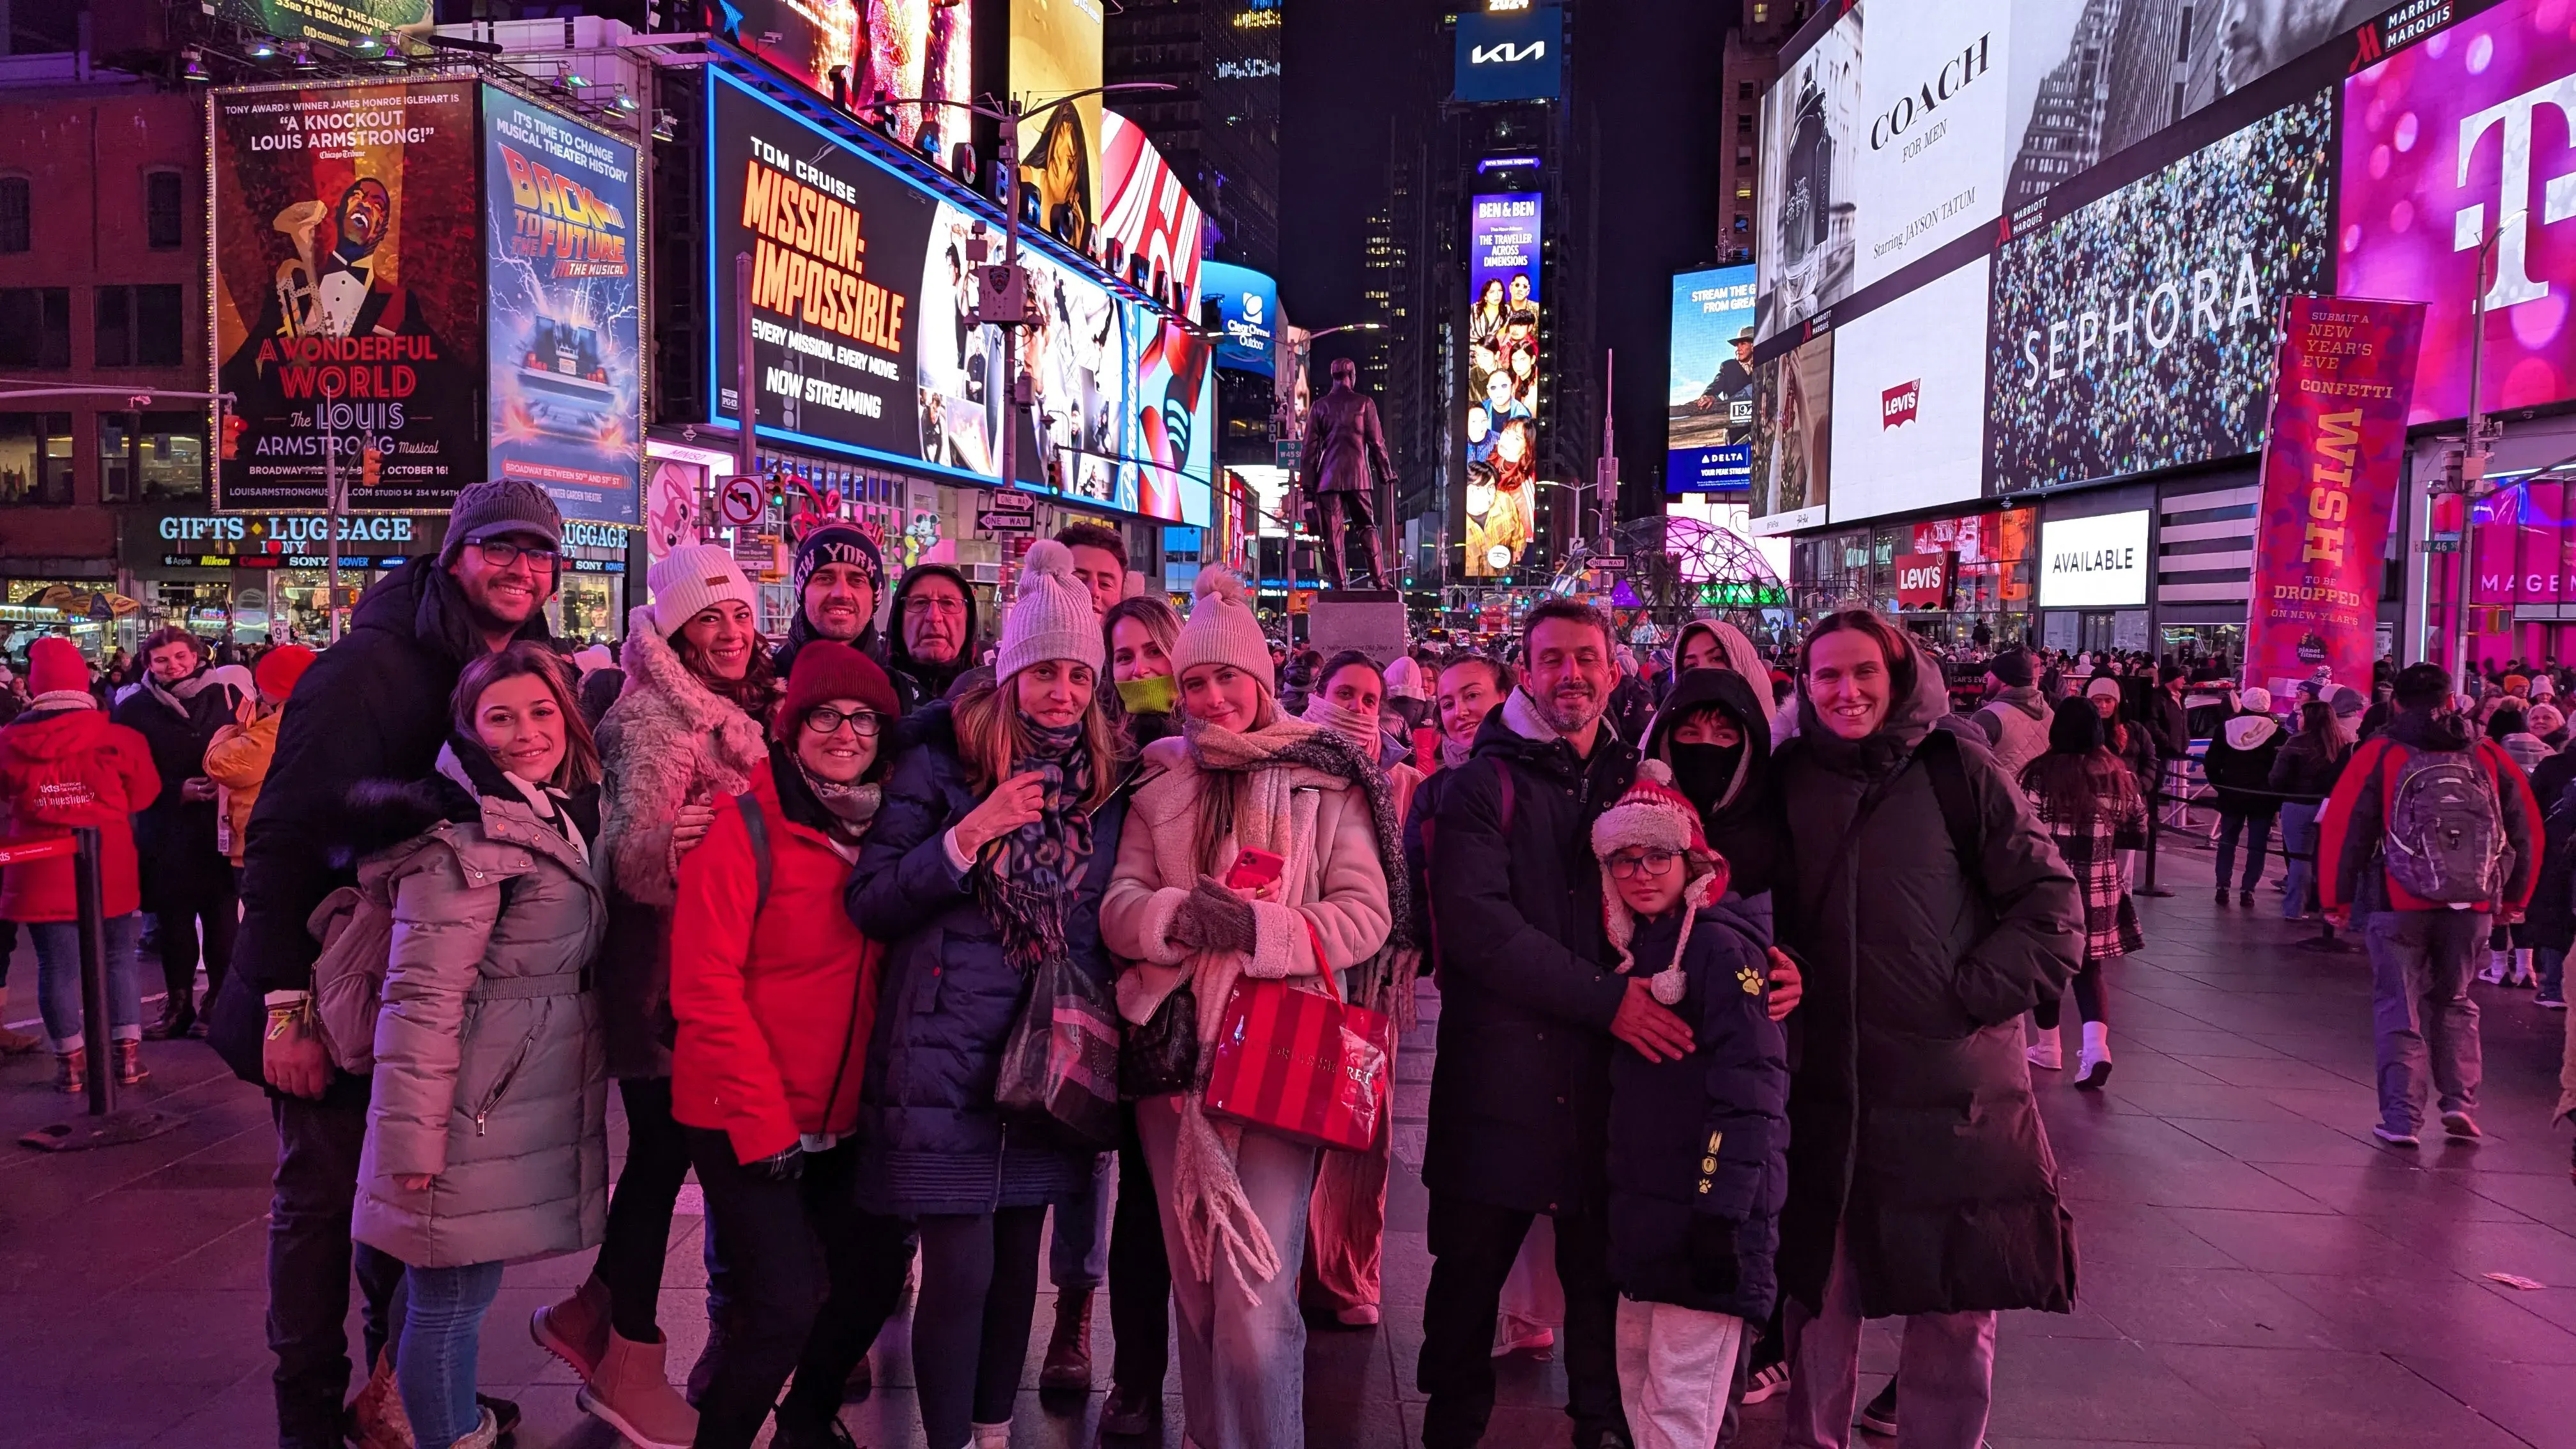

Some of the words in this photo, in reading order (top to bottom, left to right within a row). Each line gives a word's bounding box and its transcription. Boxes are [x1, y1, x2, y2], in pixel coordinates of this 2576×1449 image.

[304, 6, 312, 17] &
[315, 9, 372, 35] BROADWAY
[346, 8, 392, 31] THEATRE
[2388, 6, 2450, 48] MARQUIS
[317, 33, 349, 47] COMPANY
[1871, 31, 1991, 151] COACH
[226, 105, 249, 114] TONY
[293, 101, 328, 111] WINNER
[331, 98, 360, 109] JAMES
[362, 96, 401, 107] MONROE
[404, 95, 448, 105] IGLEHART
[450, 94, 459, 102] IS
[305, 111, 404, 129] KNOCKOUT
[251, 133, 302, 151] LOUIS
[513, 110, 532, 128] IT'S
[534, 118, 556, 140] TIME
[559, 130, 573, 145] TO
[574, 137, 613, 164] CHANGE
[1903, 138, 1922, 163] FOR
[1923, 118, 1947, 149] MEN
[319, 151, 342, 160] Chicago
[342, 150, 365, 158] Tribune
[497, 118, 542, 149] MUSICAL
[544, 139, 587, 167] THEATER
[589, 158, 628, 183] HISTORY
[751, 136, 788, 171] TOM
[795, 162, 856, 204] CRUISE
[500, 142, 617, 230] BACK
[742, 160, 866, 275] MISSION:
[1479, 203, 1501, 218] BEN
[1503, 202, 1512, 217] &
[1512, 201, 1535, 217] BEN
[2013, 196, 2048, 222] MARRIOTT
[1874, 233, 1903, 259] Starring
[1905, 208, 1940, 245] JAYSON
[1941, 186, 1976, 221] TATUM
[2013, 212, 2043, 234] MARQUIS
[514, 209, 540, 236] TO
[540, 221, 626, 263] FUTURE
[1479, 235, 1492, 245] THE
[1494, 234, 1532, 245] TRAVELLER
[511, 236, 539, 257] THE
[1492, 245, 1519, 256] ACROSS
[569, 263, 586, 275] THE
[588, 263, 624, 275] MUSICAL
[1483, 256, 1528, 267] DIMENSIONS
[751, 238, 905, 353] IMPOSSIBLE
[1692, 287, 1728, 302] STREAM
[1729, 284, 1747, 297] THE
[1703, 300, 1729, 313] FROM
[1731, 296, 1755, 310] GREA
[1227, 319, 1248, 333] Clear
[1813, 310, 1832, 326] MARRIOTT
[2023, 252, 2261, 388] SEPHORA
[2312, 312, 2359, 323] SUBMIT
[2361, 315, 2369, 323] A
[1812, 321, 1829, 335] MARQUIS
[2308, 324, 2354, 338] NEW
[256, 339, 277, 362] A
[280, 335, 438, 361] WONDERFUL
[752, 319, 786, 345] EVERY
[788, 332, 835, 361] MISSION.
[837, 345, 868, 371] EVERY
[869, 356, 899, 381] MOVIE.
[1239, 335, 1264, 351] Outdoor
[2307, 340, 2372, 356] YEAR'S
[2303, 355, 2339, 369] EVE
[279, 365, 417, 399] WORLD
[2301, 379, 2393, 399] CONFETTI
[766, 367, 804, 399] NOW
[805, 378, 882, 419] STREAMING
[290, 411, 312, 427] The
[317, 402, 404, 430] LOUIS
[1268, 404, 1277, 443] 1500
[399, 440, 439, 454] Musical
[670, 449, 707, 461] MINISO
[1712, 453, 1743, 462] DELTA
[249, 466, 302, 475] BROADWAY
[387, 466, 433, 475] OCTOBER
[436, 466, 448, 475] 16!
[506, 463, 542, 475] BROADWAY
[544, 468, 574, 479] BETWEEN
[549, 488, 565, 499] WINTER
[567, 489, 584, 500] GARDEN
[585, 491, 602, 502] THEATRE
[2303, 408, 2363, 567] WISH
[160, 517, 244, 540] GIFTS
[268, 517, 411, 540] LUGGAGE
[986, 517, 1001, 525] ONE
[560, 524, 628, 549] UGGAGE
[282, 541, 307, 554] NY
[2435, 542, 2447, 551] 46
[173, 556, 192, 565] Apple
[201, 556, 231, 566] Nikon
[289, 556, 330, 566] SONY
[339, 557, 369, 567] BOWER
[576, 561, 602, 570] SONY
[823, 543, 877, 578] YORK
[2052, 547, 2133, 574] AVAILABLE
[2305, 576, 2320, 585] TO
[2324, 577, 2336, 586] BE
[2274, 585, 2360, 606] DROPPED
[2272, 609, 2287, 618] ON
[2290, 610, 2317, 620] NEW
